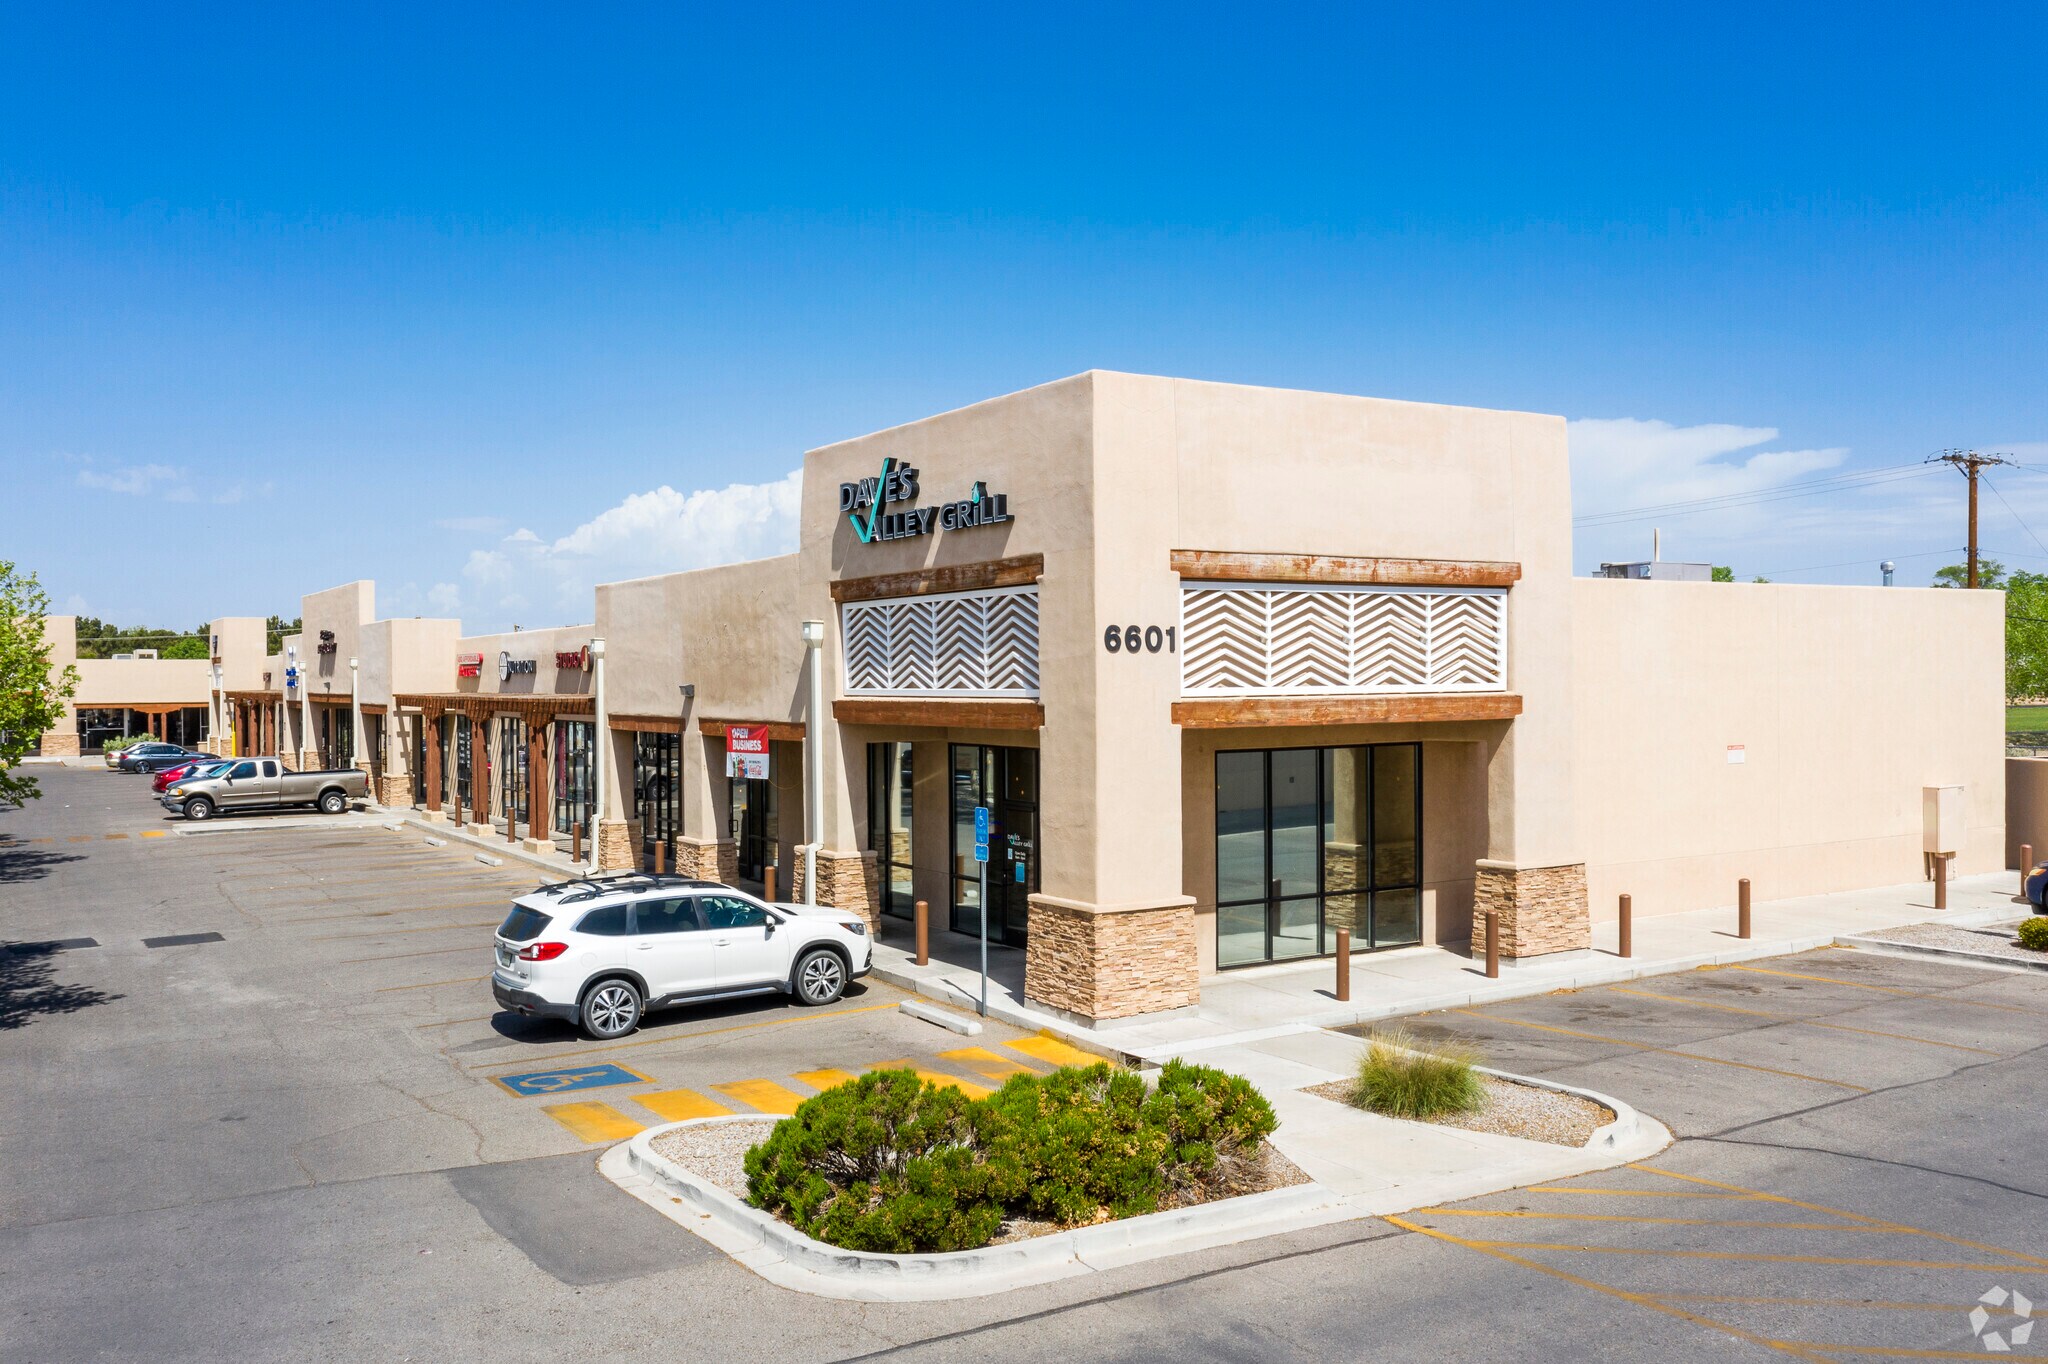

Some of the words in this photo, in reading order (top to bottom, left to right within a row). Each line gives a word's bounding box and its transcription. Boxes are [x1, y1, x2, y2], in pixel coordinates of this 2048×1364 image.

[839, 461, 920, 513] DAVE'S
[848, 457, 940, 544] VALLEY
[1104, 624, 1176, 654] 6601
[507, 660, 535, 674] NUTRITION
[731, 728, 749, 739] OPEN
[732, 739, 762, 751] BUSINESS
